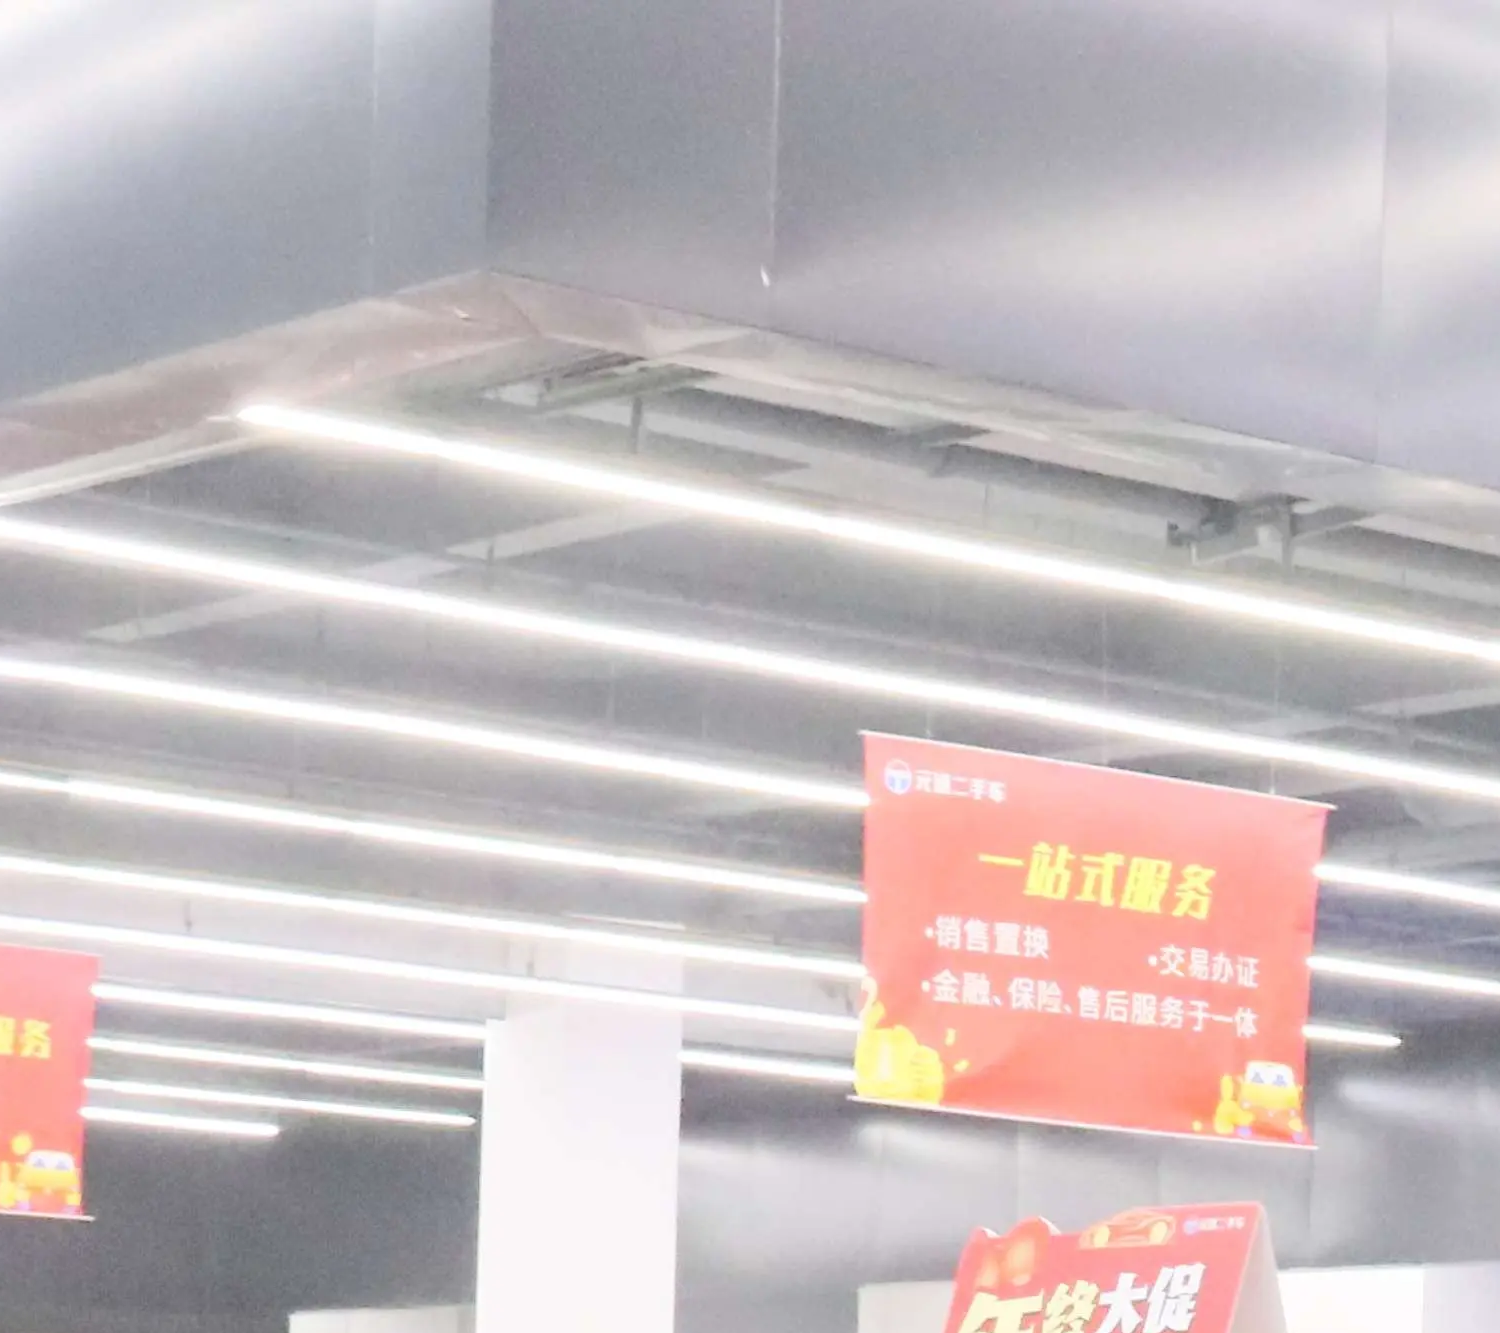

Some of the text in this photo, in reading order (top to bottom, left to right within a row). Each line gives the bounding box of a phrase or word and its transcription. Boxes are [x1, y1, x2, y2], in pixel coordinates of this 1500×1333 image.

[978, 841, 1218, 921] 一站式服务
[934, 915, 1260, 989] 销售置换 交易办证
